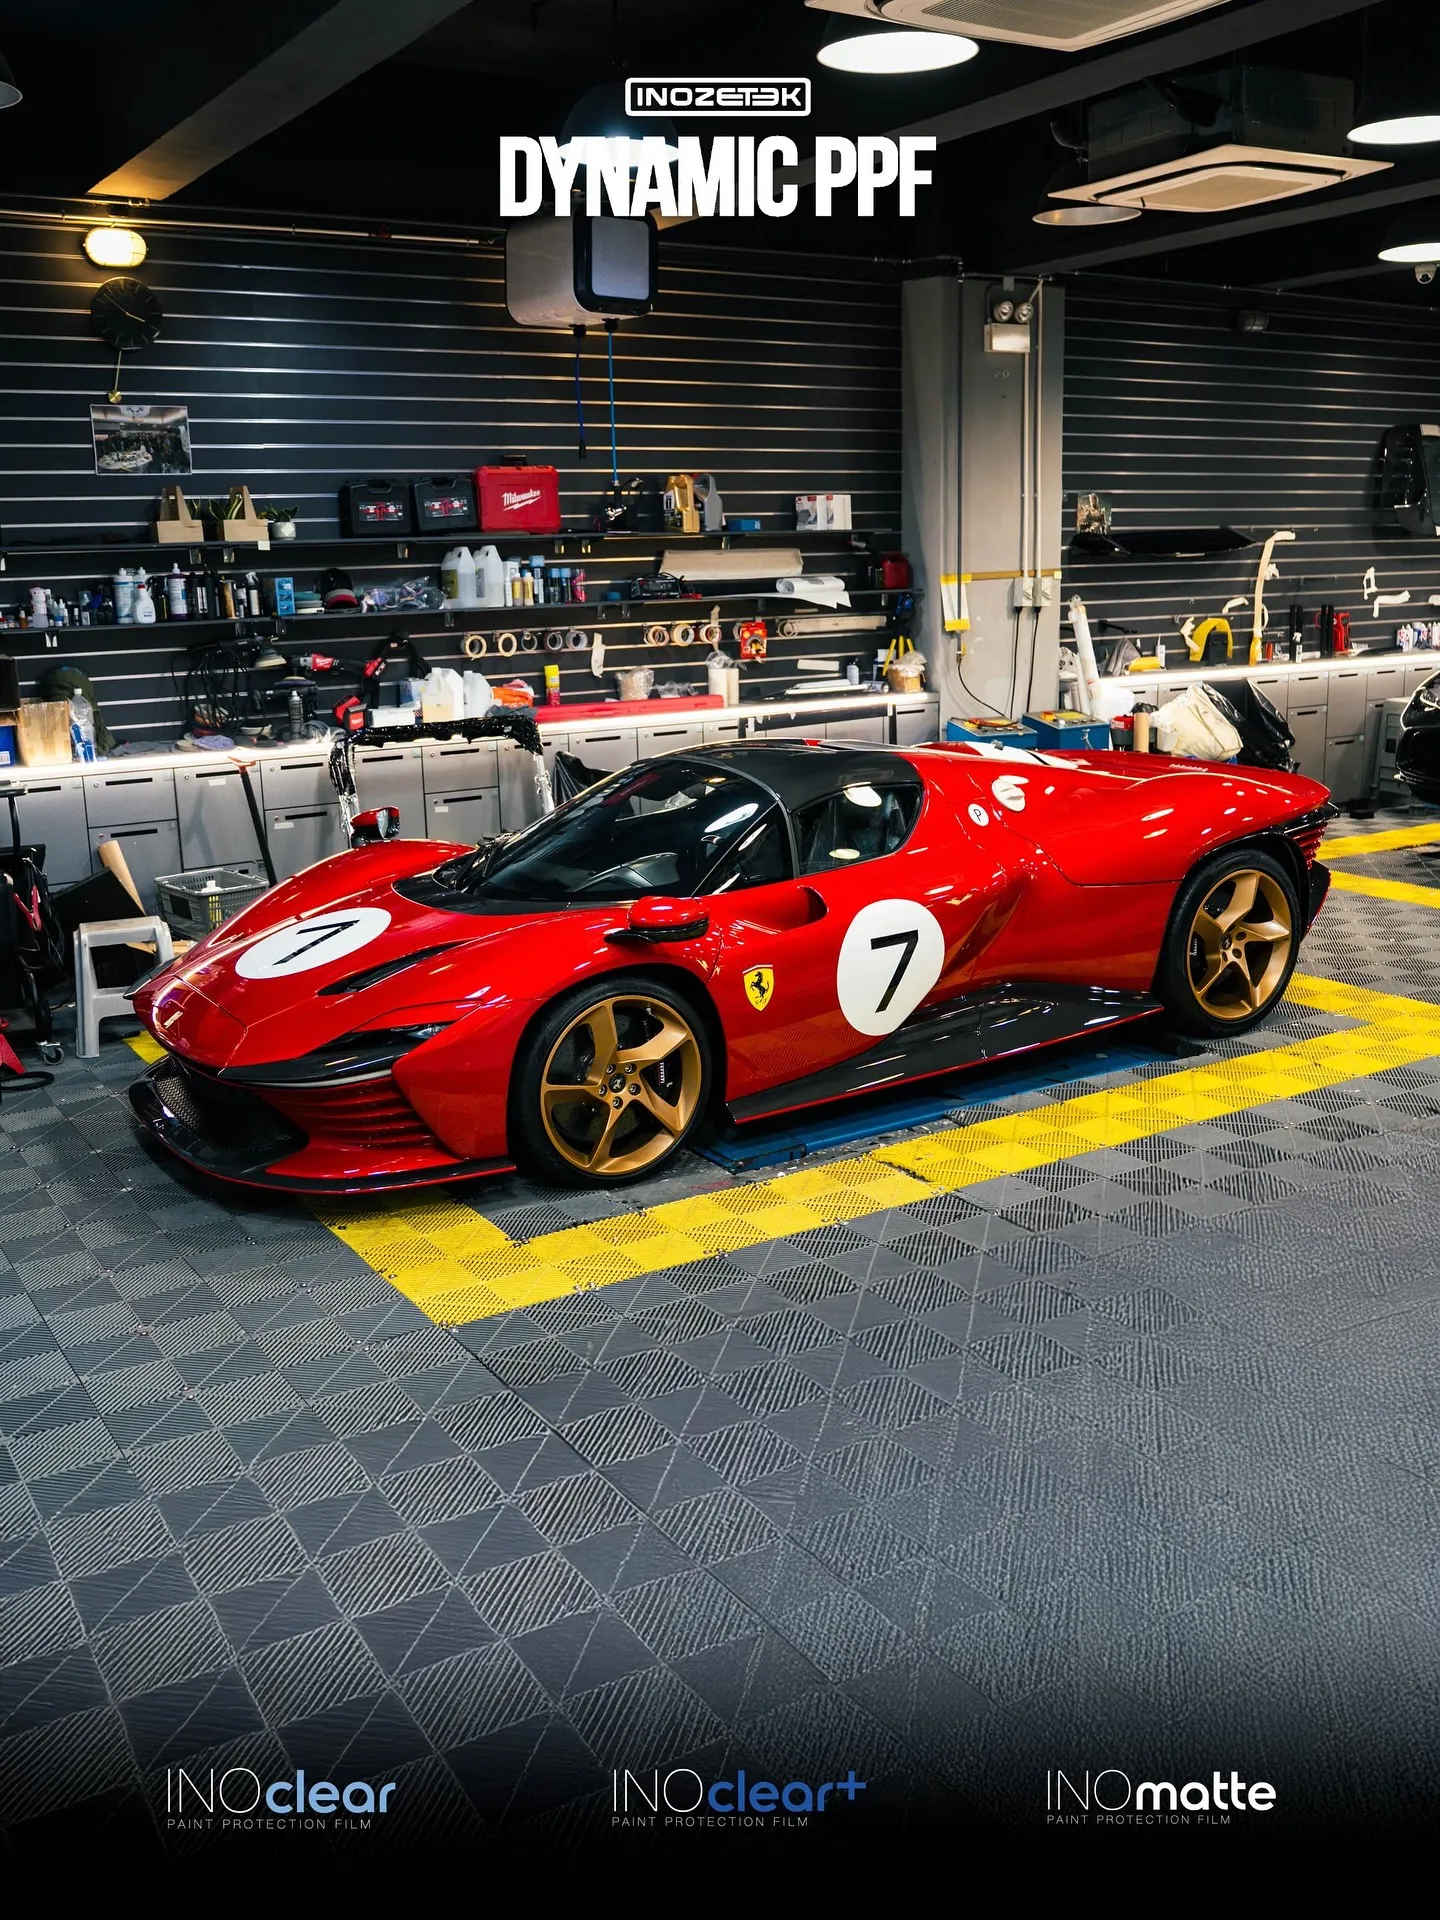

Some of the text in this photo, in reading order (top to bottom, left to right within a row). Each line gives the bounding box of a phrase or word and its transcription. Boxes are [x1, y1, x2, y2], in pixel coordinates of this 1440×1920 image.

[501, 488, 541, 507] Milwaukee
[973, 808, 982, 823] P
[273, 918, 360, 965] 7
[870, 929, 919, 1013] 7
